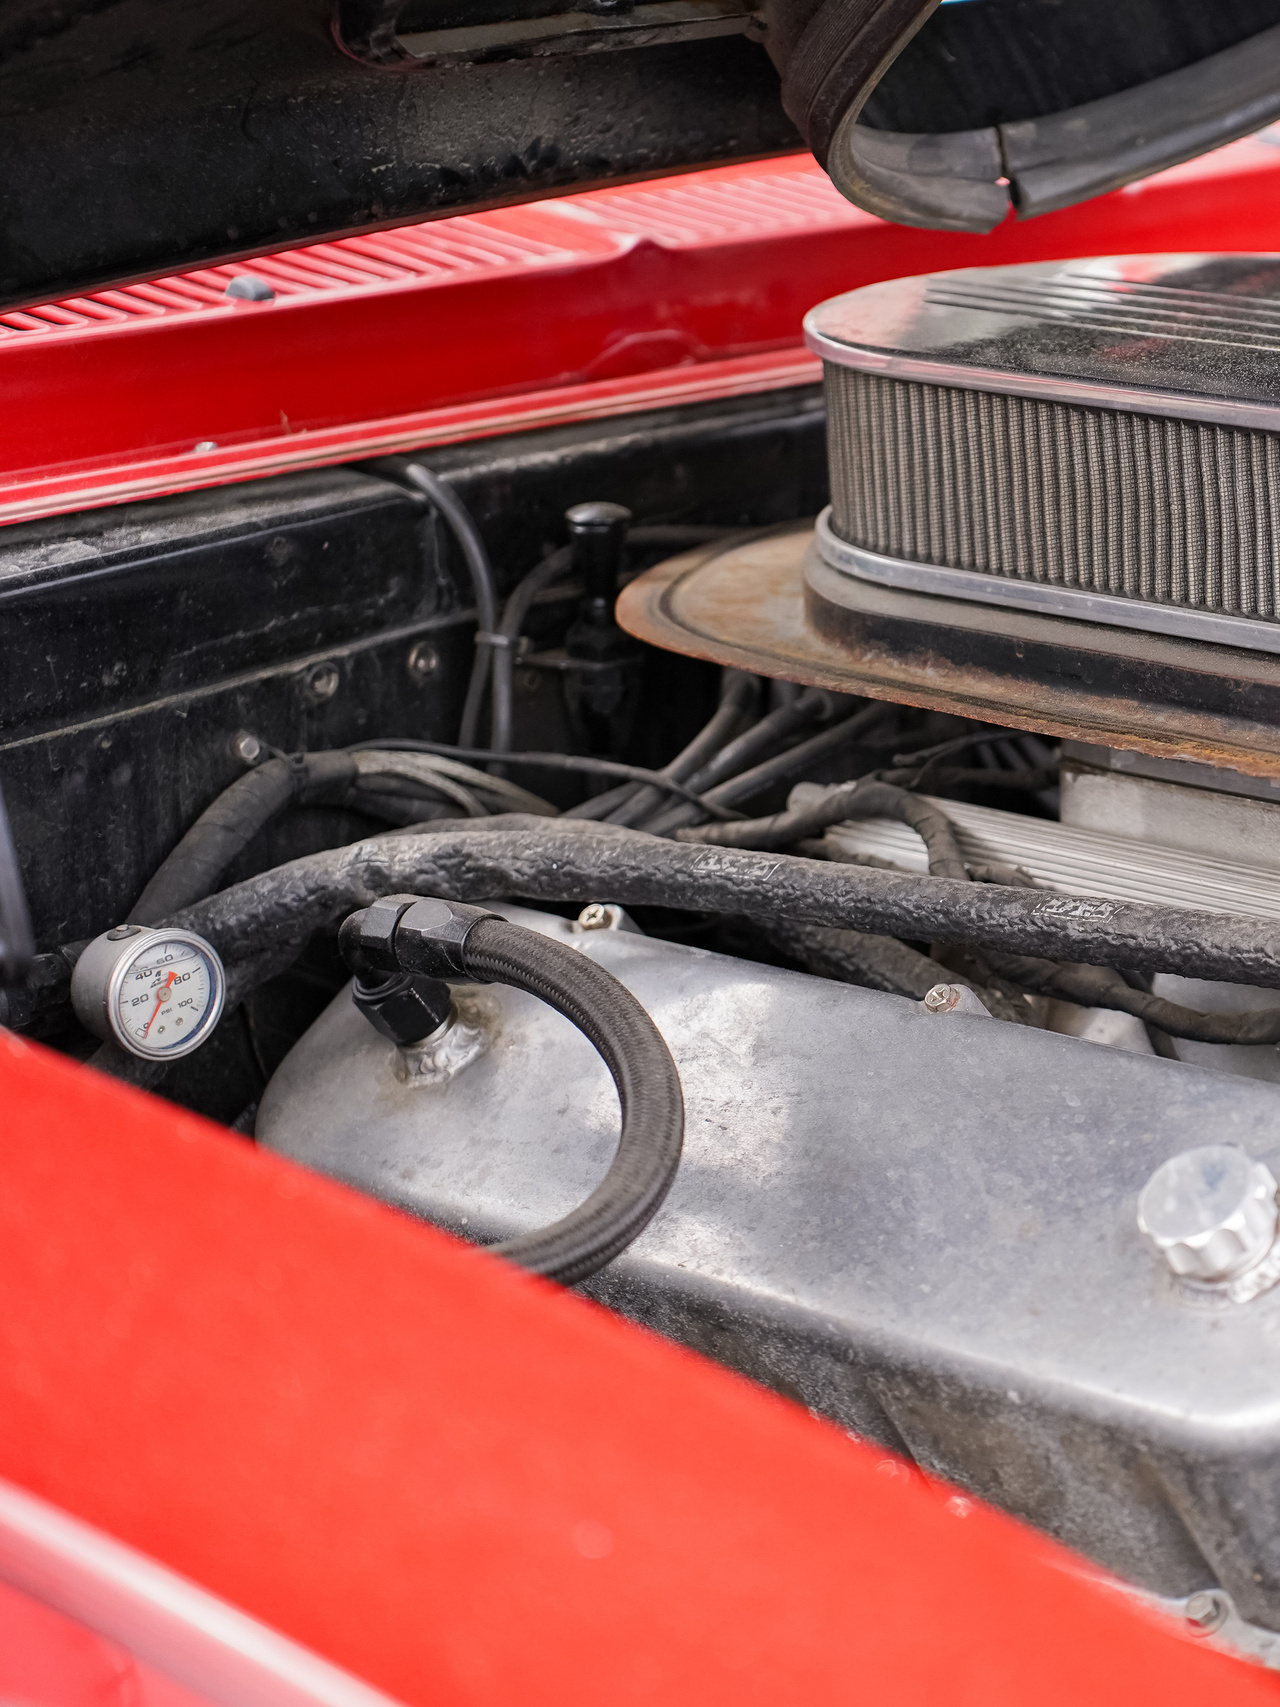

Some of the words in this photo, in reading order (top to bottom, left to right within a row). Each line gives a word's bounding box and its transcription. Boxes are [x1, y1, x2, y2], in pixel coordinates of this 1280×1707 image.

[156, 954, 173, 964] 60
[135, 966, 153, 980] 40
[174, 972, 191, 985] 80
[131, 994, 149, 1006] 20
[178, 998, 193, 1008] 100
